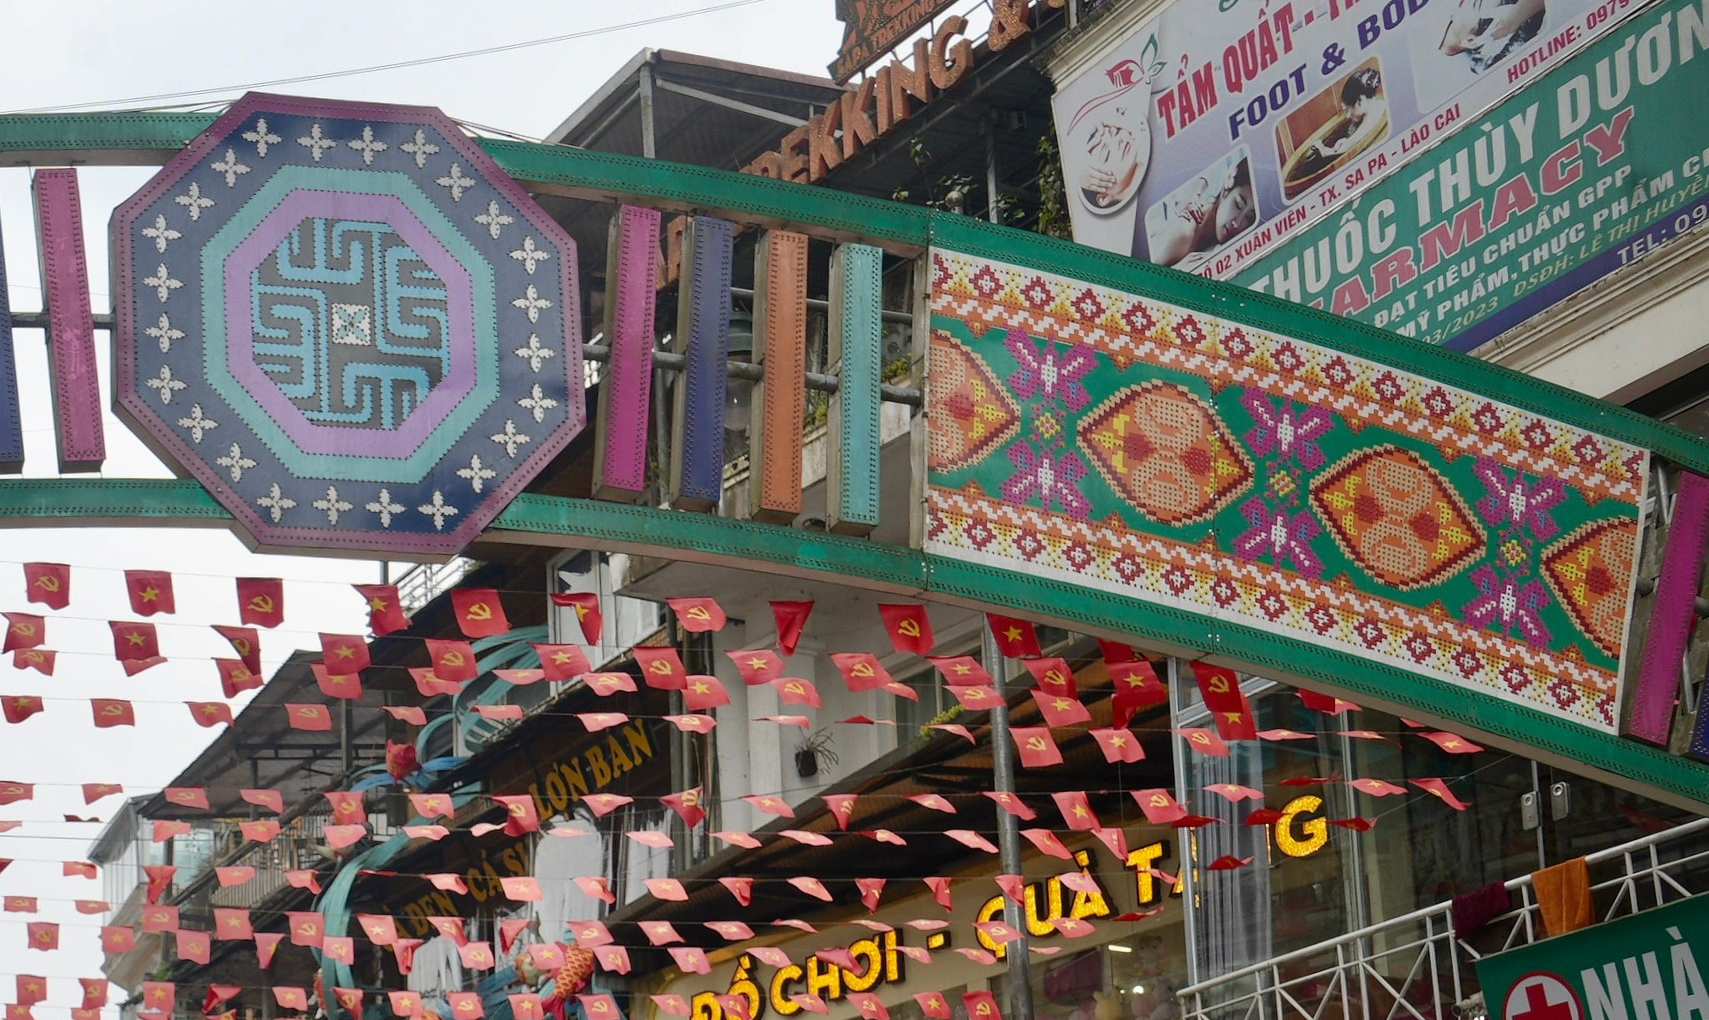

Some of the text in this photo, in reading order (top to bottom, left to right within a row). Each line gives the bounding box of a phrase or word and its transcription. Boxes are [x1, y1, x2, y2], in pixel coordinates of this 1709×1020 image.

[1228, 42, 1346, 141] FOOT &
[1507, 24, 1582, 84] HOTLINE:
[1215, 103, 1461, 275] 02 XUÂN VIÊN TX. SA PA LÀO CAI
[1409, 102, 1539, 228] THÙY
[1423, 254, 1477, 301] TIÊU
[1483, 200, 1570, 265] CHUẨN
[1578, 164, 1632, 209] GPP
[1518, 223, 1585, 276] THỰC
[1593, 170, 1674, 231] PHẨM
[1579, 233, 1603, 261] LÊ
[1607, 217, 1640, 243] THỊ
[1618, 227, 1668, 266] TEL:
